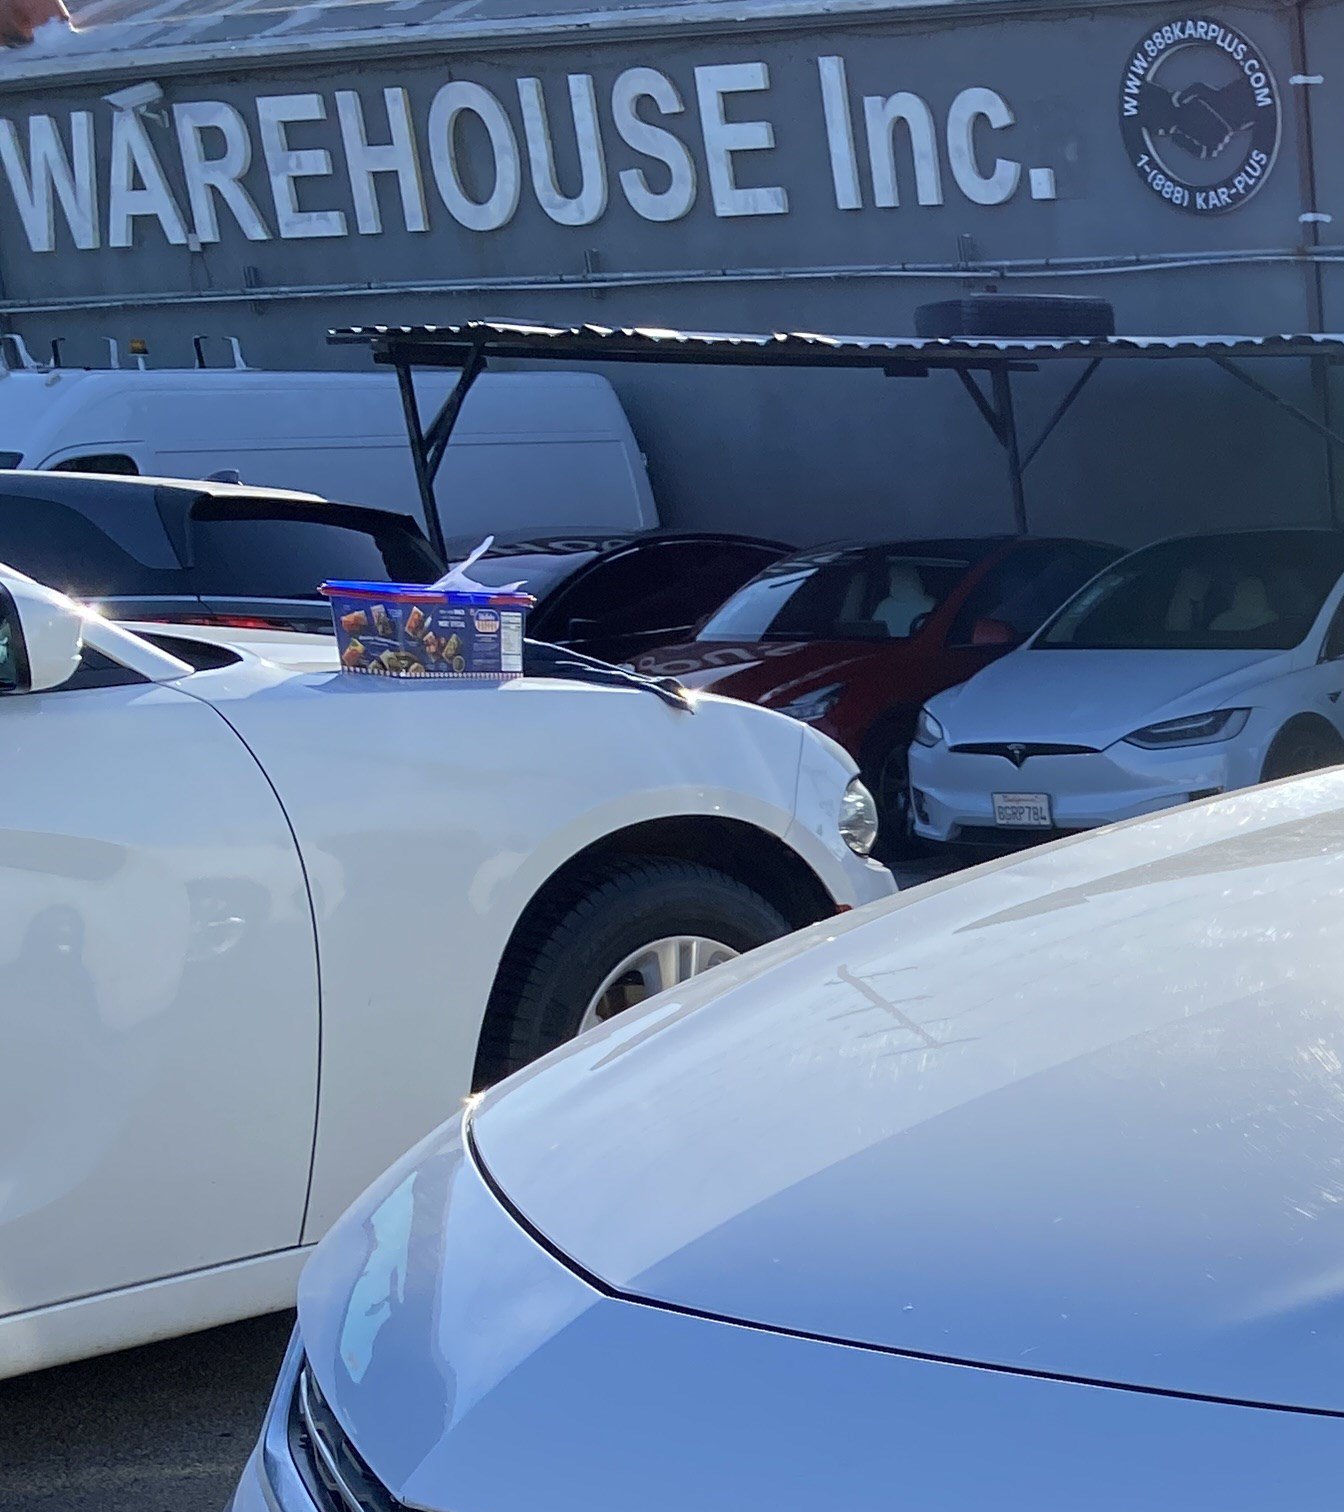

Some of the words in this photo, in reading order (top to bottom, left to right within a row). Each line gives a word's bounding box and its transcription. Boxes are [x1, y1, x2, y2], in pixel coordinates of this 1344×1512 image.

[1122, 20, 1274, 117] WWW.888KARPLUS.COM
[0, 62, 789, 253] WAREHOUSE
[818, 55, 1057, 210] Inc.
[1195, 149, 1268, 210] KAR-PLUS
